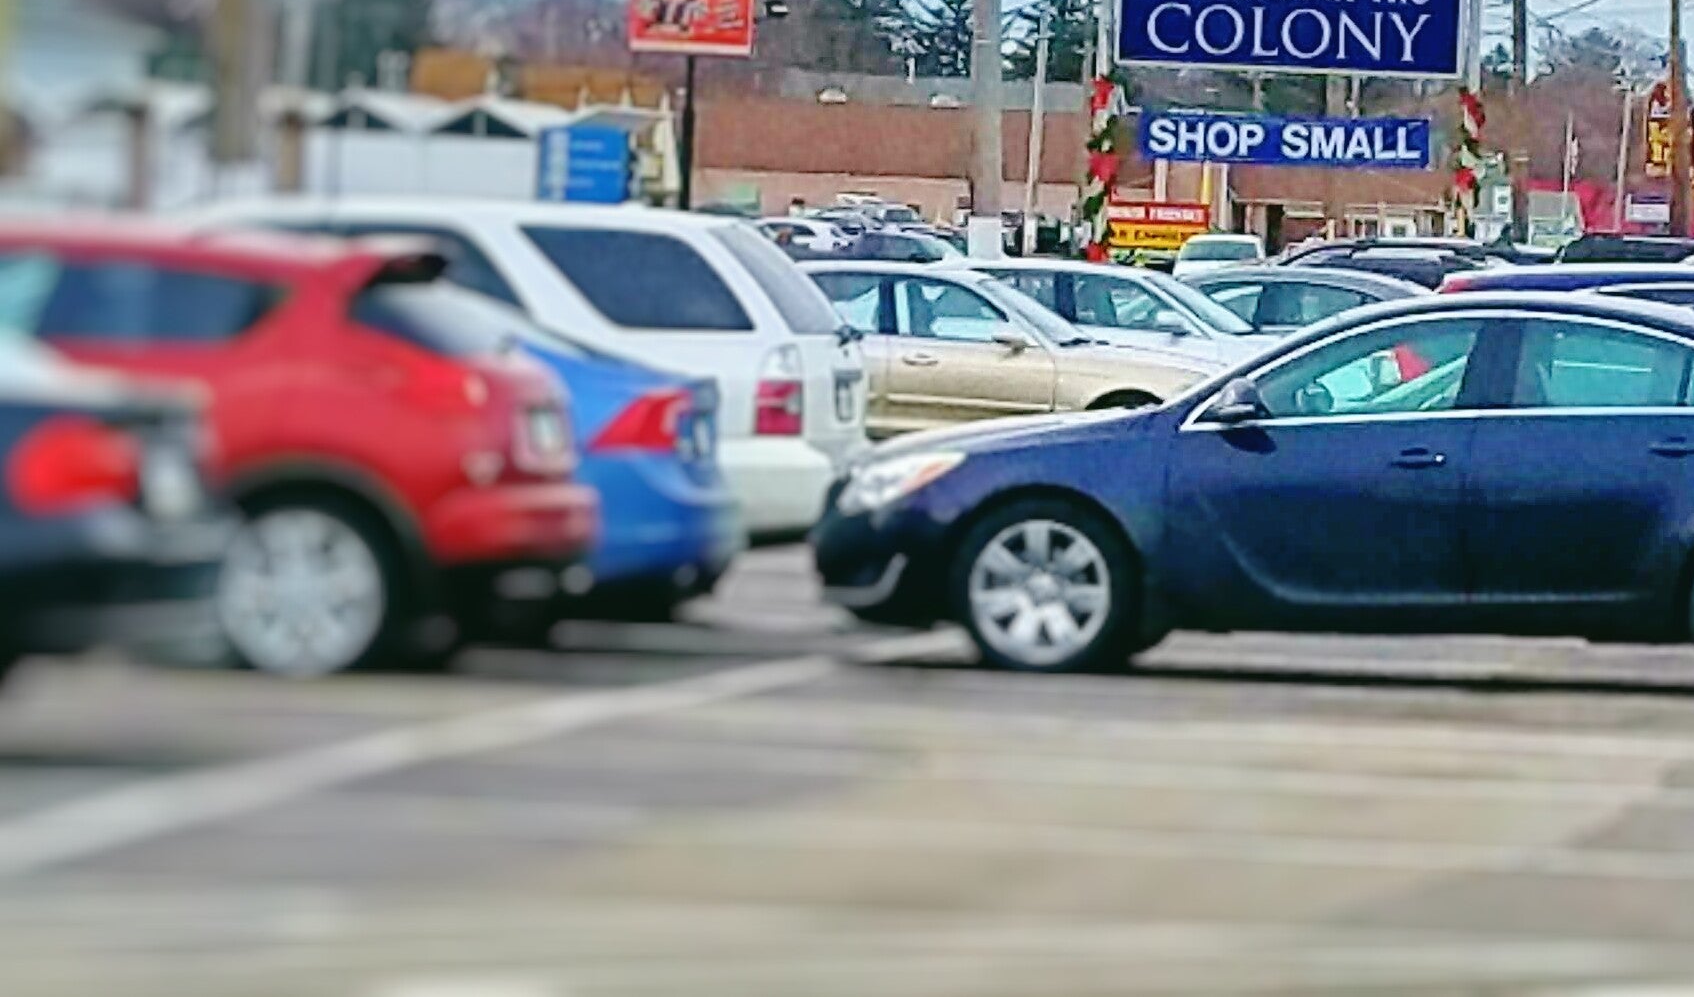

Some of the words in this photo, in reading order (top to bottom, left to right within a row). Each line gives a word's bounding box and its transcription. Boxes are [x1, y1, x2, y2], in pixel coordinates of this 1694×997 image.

[1147, 3, 1430, 62] COLONY
[1148, 121, 1265, 156] SHOP
[1282, 124, 1422, 161] SMALL
